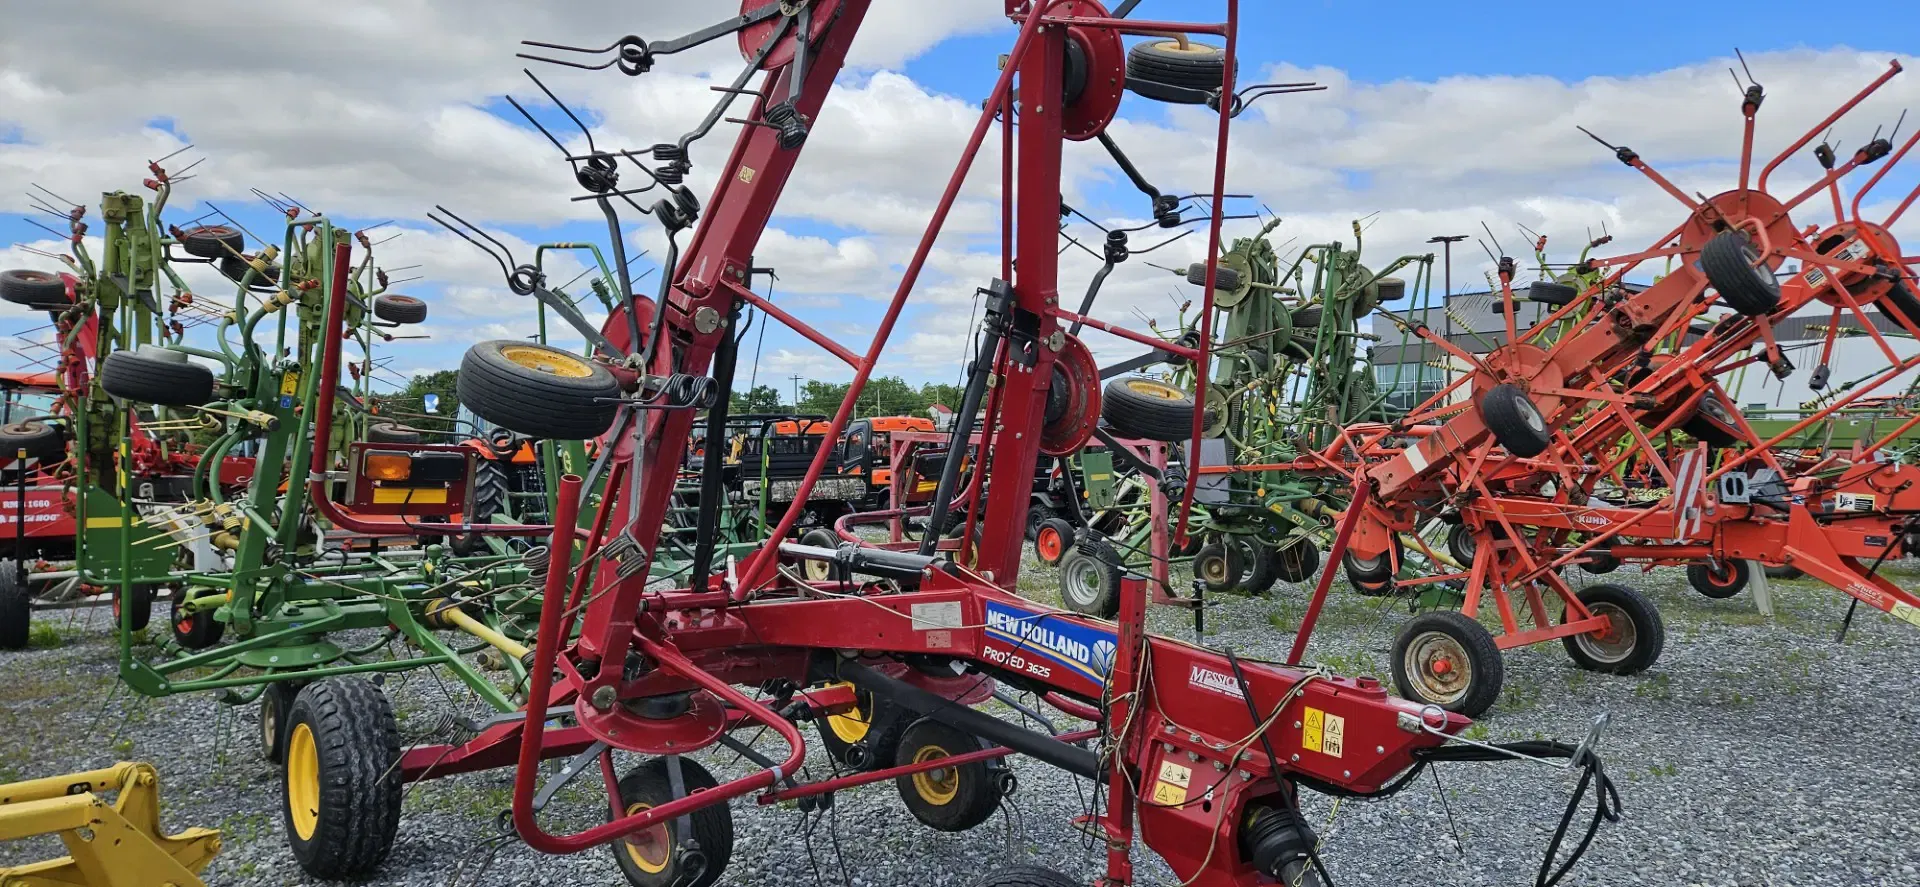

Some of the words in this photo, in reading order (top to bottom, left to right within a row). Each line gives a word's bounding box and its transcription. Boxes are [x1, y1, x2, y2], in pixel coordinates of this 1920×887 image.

[3, 500, 25, 509] RM
[1578, 515, 1607, 525] KUHN
[987, 609, 1018, 635] NEW
[1020, 620, 1090, 664] HOLLAND
[983, 645, 1025, 669] PROTED
[1026, 662, 1051, 678] 3625
